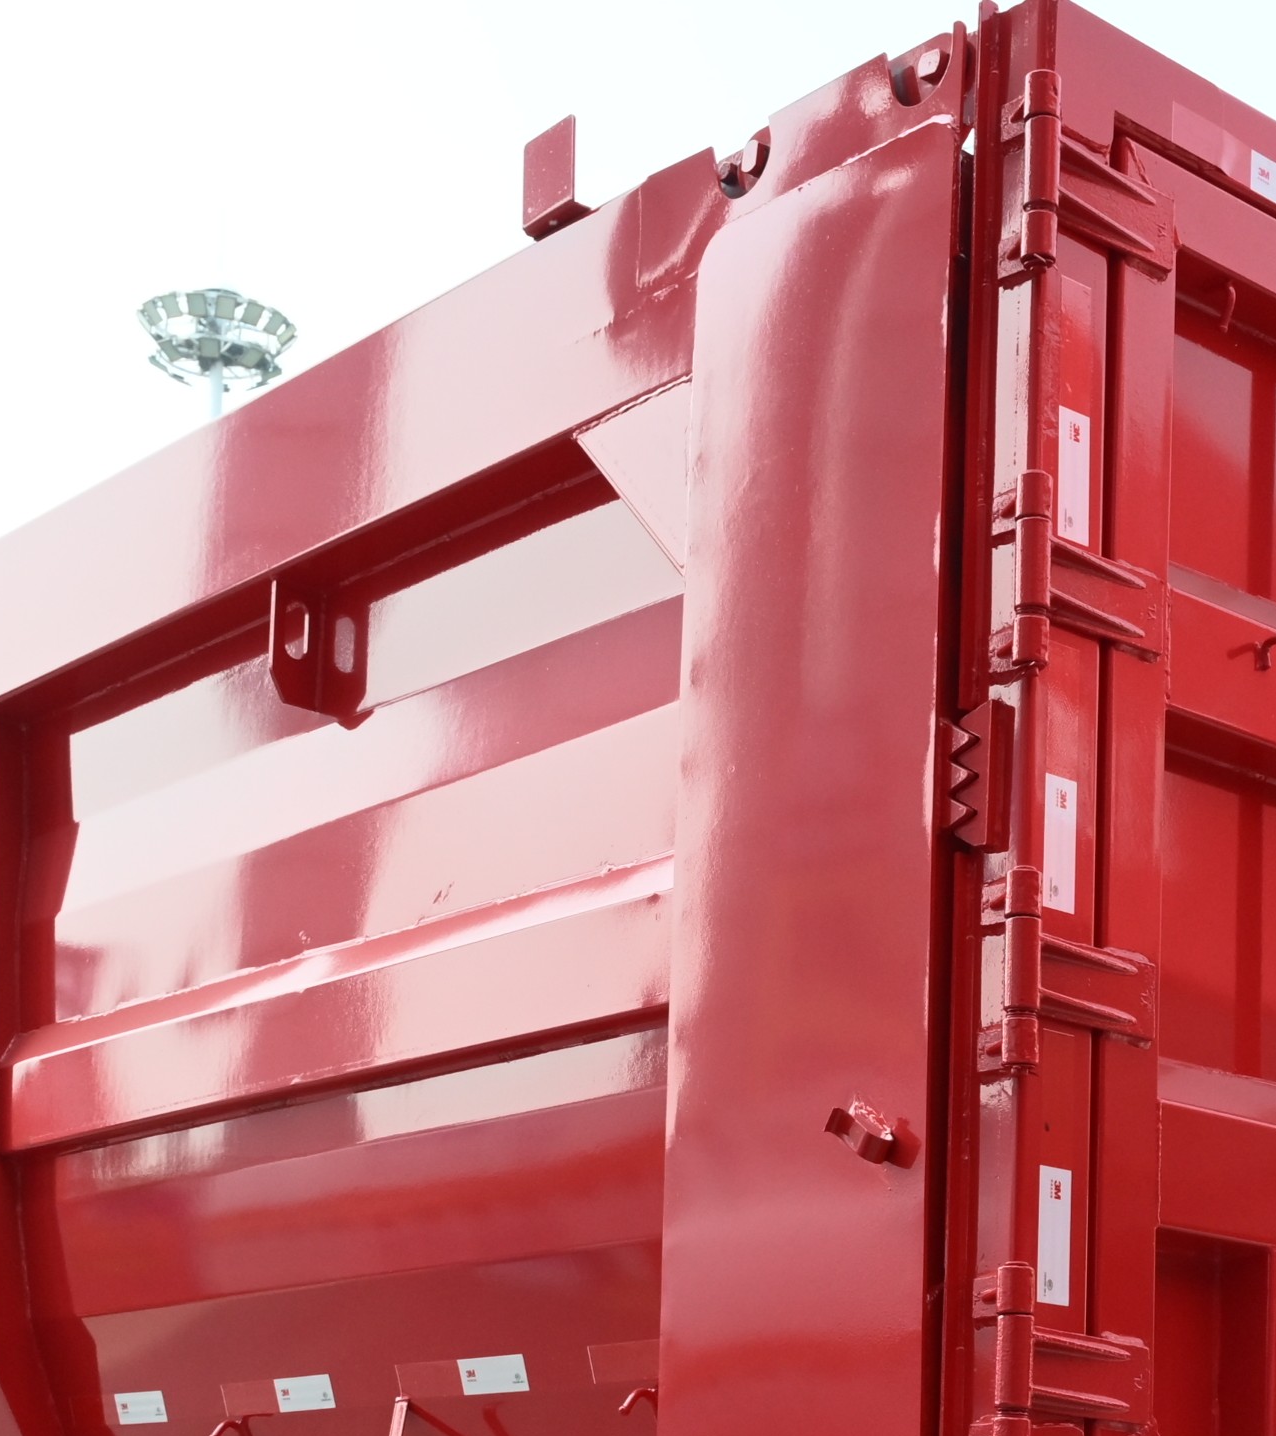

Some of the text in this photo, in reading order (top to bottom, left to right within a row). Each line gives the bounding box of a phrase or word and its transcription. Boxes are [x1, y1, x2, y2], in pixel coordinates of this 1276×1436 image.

[1258, 166, 1270, 180] 3M
[1073, 422, 1081, 443] 3M
[1059, 789, 1067, 810] 3M
[1053, 1179, 1062, 1200] 3M
